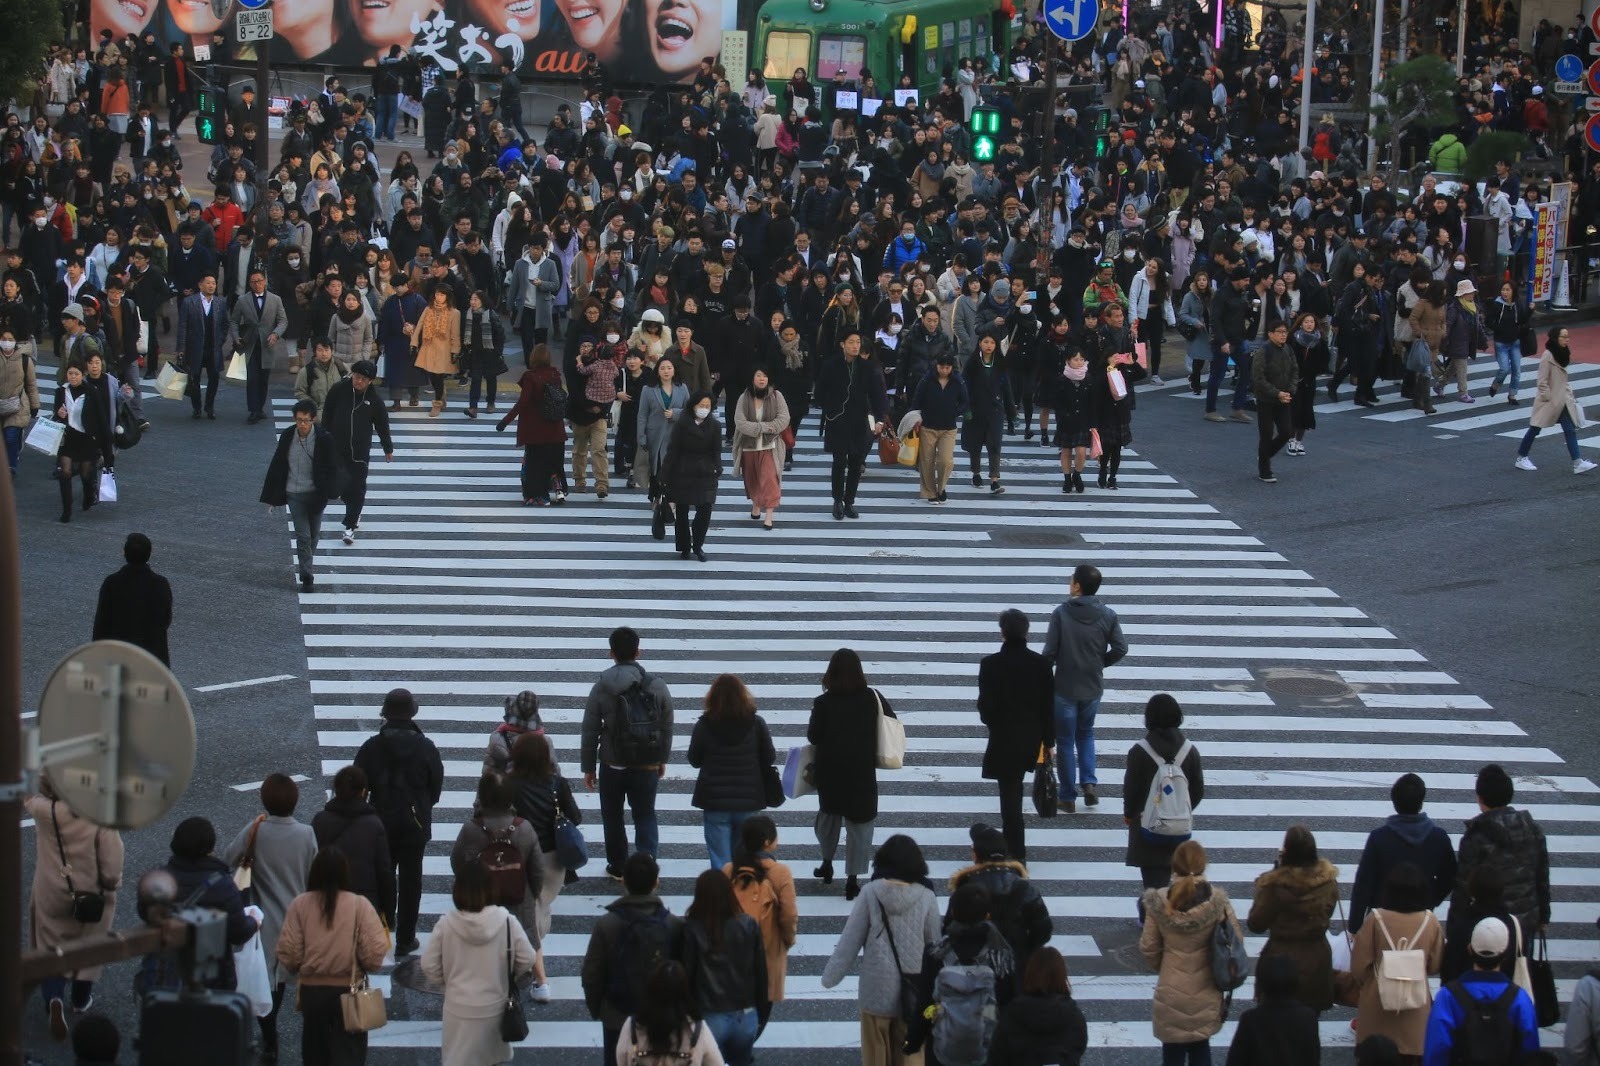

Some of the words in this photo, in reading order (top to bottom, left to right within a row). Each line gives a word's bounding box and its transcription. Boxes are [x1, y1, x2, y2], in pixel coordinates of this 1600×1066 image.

[410, 9, 524, 72] 笑おう
[535, 50, 588, 73] au
[1533, 211, 1547, 295] 駐停車禁止
[1542, 210, 1556, 293] バス停につき
